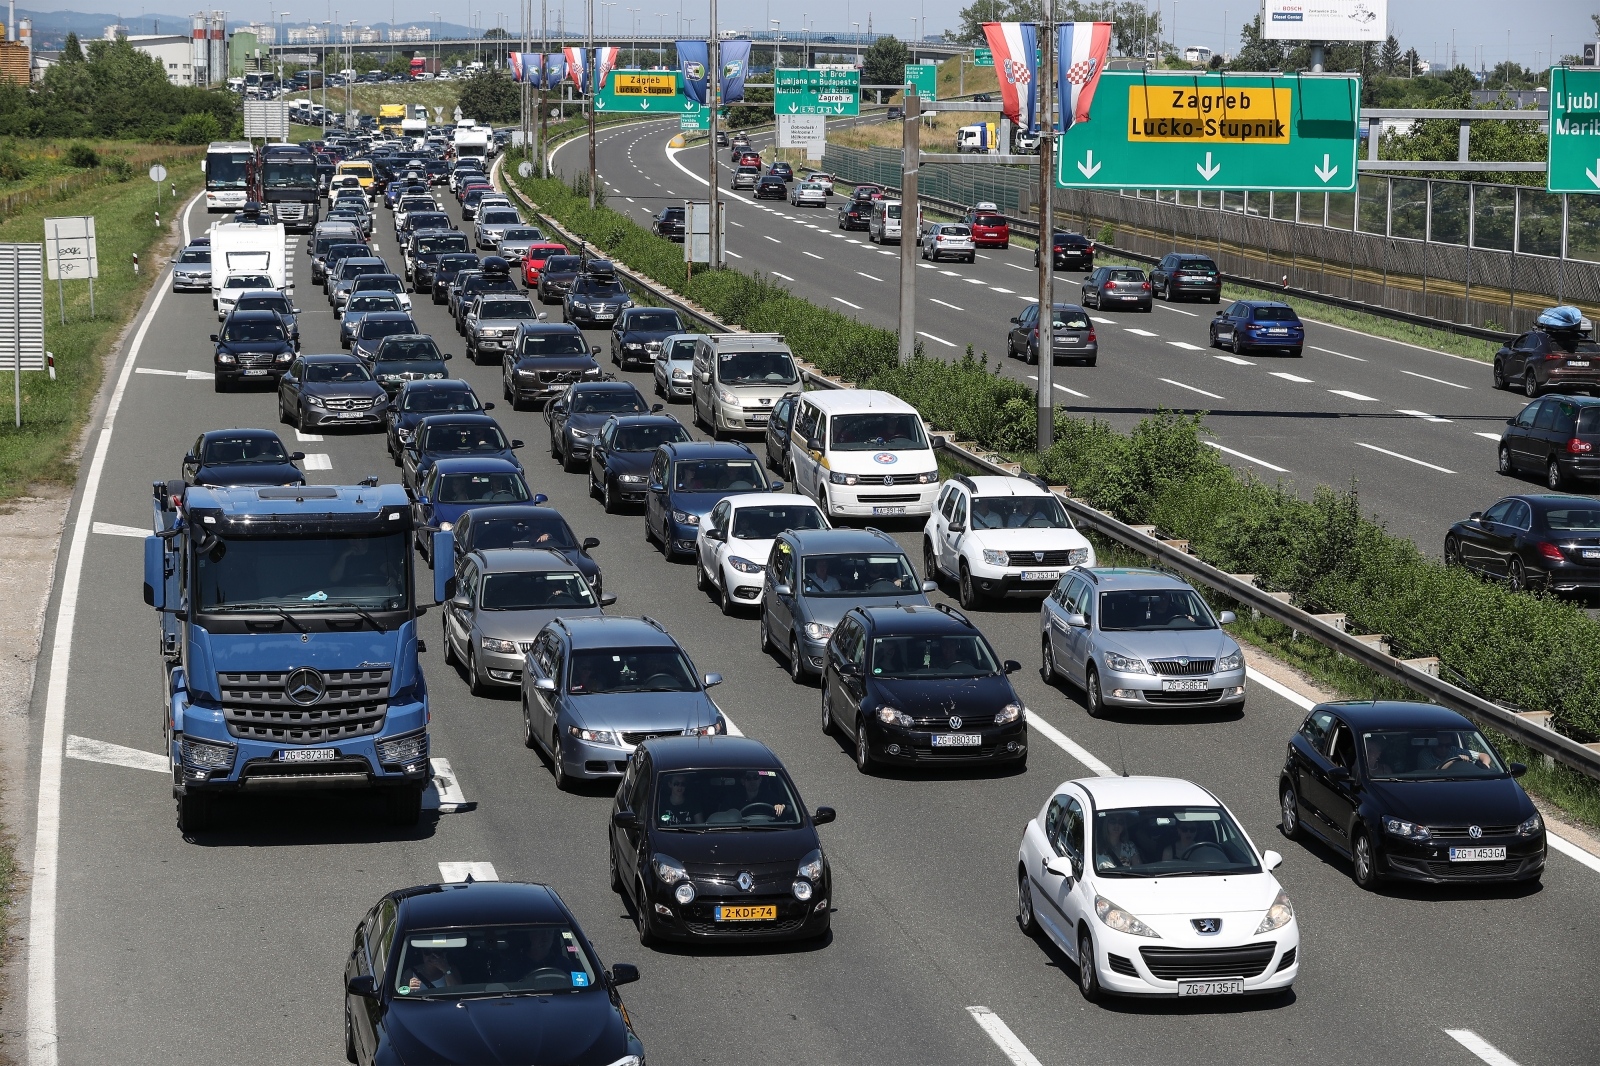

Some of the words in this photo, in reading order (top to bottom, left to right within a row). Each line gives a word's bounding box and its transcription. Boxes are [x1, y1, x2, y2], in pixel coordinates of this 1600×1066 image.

[630, 76, 660, 85] Zagreb
[1172, 90, 1251, 113] Zagreb
[1557, 92, 1600, 113] Ljubl
[1132, 117, 1285, 141] Lučko-Stupnik
[938, 735, 947, 744] ZG
[285, 751, 296, 760] ZG
[1456, 850, 1467, 859] ZG
[725, 907, 772, 918] 2-KDF-74
[1186, 984, 1198, 995] ZG
